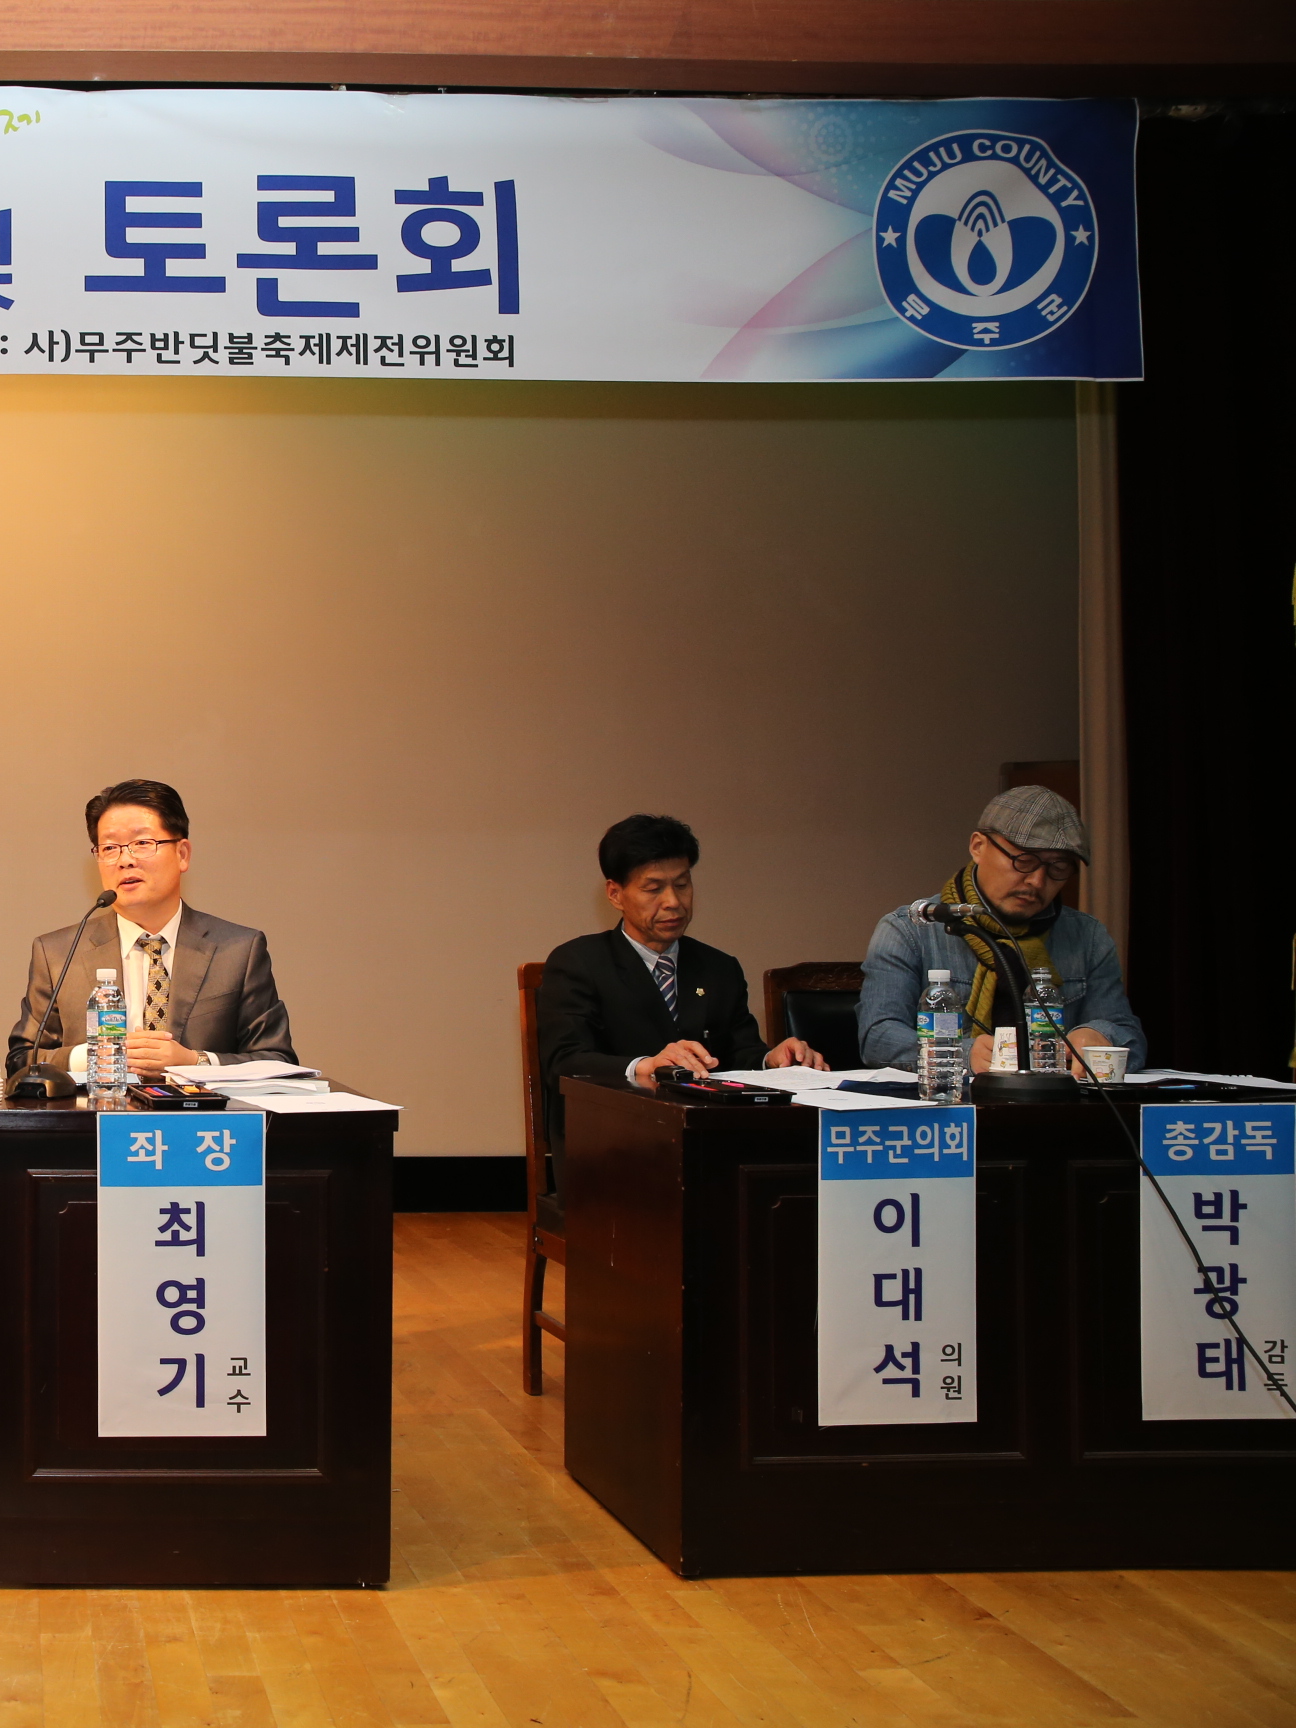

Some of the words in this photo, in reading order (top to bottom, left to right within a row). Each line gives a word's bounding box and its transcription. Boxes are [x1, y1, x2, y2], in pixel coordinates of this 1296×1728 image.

[888, 142, 963, 205] MUJU
[972, 138, 1085, 210] COUNTY
[84, 175, 520, 318] 토론회
[24, 330, 515, 367] 사)무주반딧불축제제전위원회
[826, 1122, 968, 1164] 무주군의회
[1162, 1120, 1278, 1160] 총감독
[154, 1201, 206, 1408] 최영기
[872, 1192, 923, 1398] 이대석
[226, 1357, 251, 1414] 교수
[940, 1342, 963, 1401] 의원
